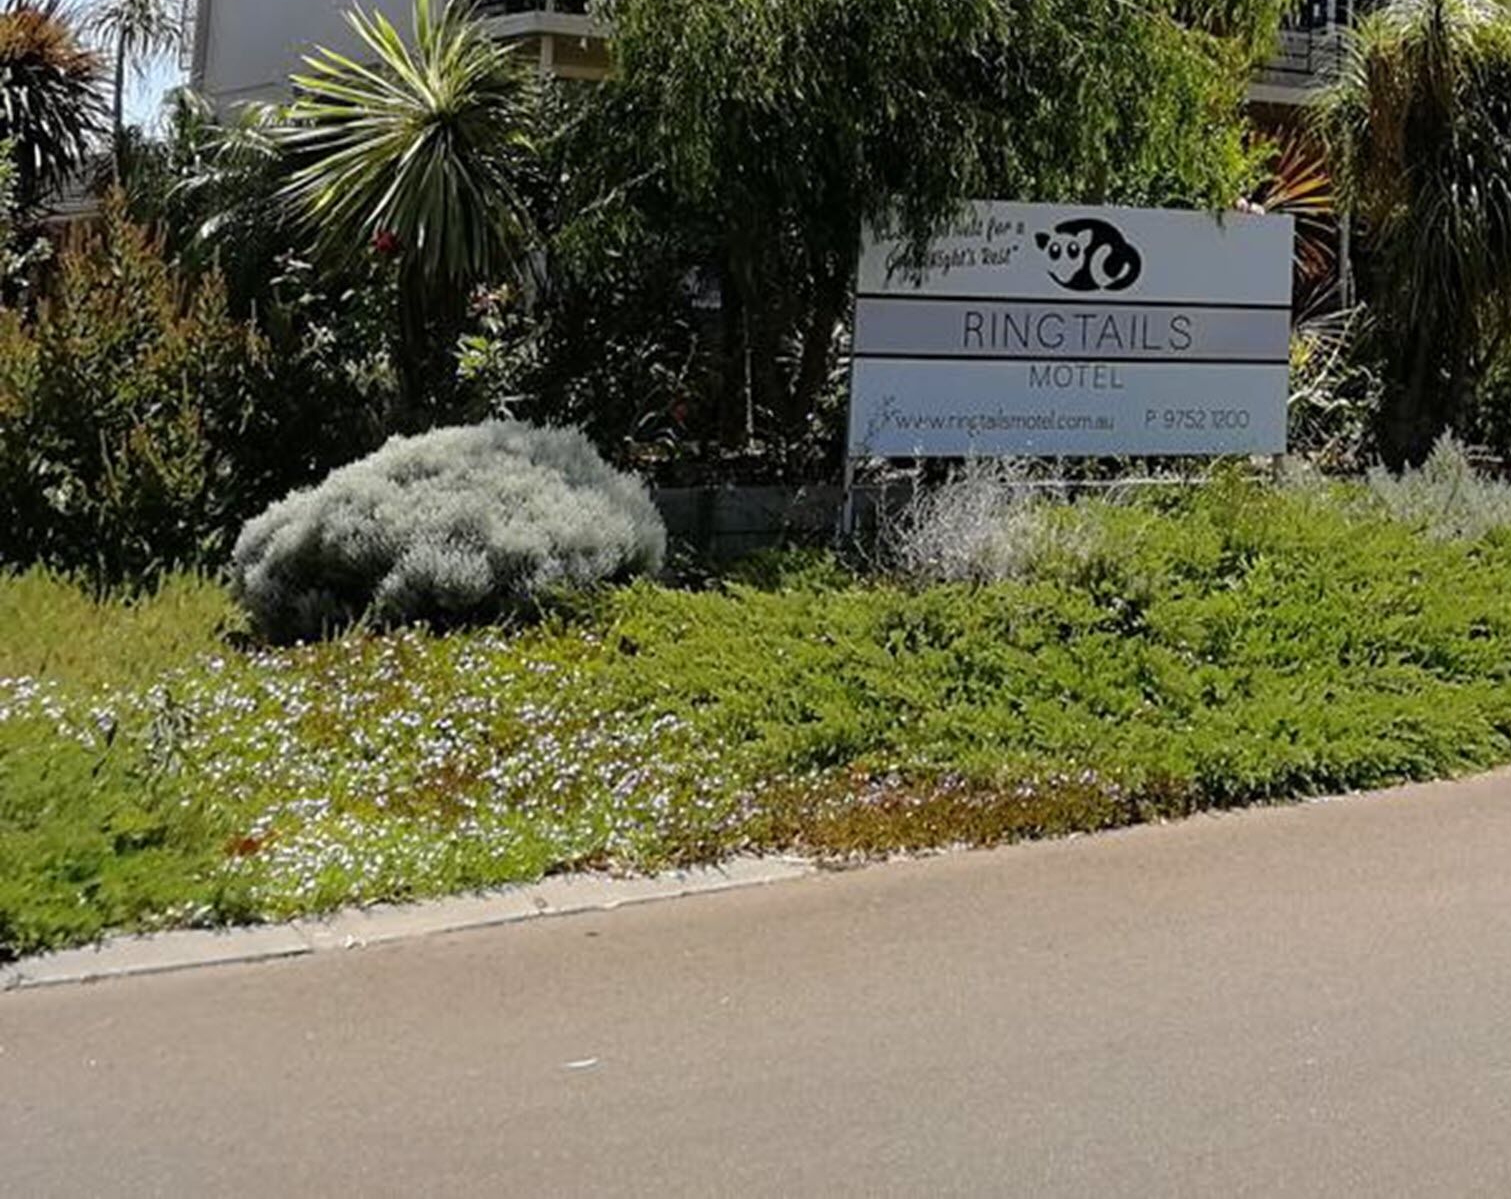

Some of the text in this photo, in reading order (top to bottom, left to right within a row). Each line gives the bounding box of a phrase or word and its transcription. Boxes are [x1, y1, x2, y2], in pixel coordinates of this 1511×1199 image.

[962, 310, 1193, 351] RINGTAILS
[1028, 364, 1124, 390] MOTEL
[896, 406, 1114, 436] www.ringtailsmotel.com.au
[1163, 408, 1206, 429] 9752
[1211, 408, 1251, 429] 1200
